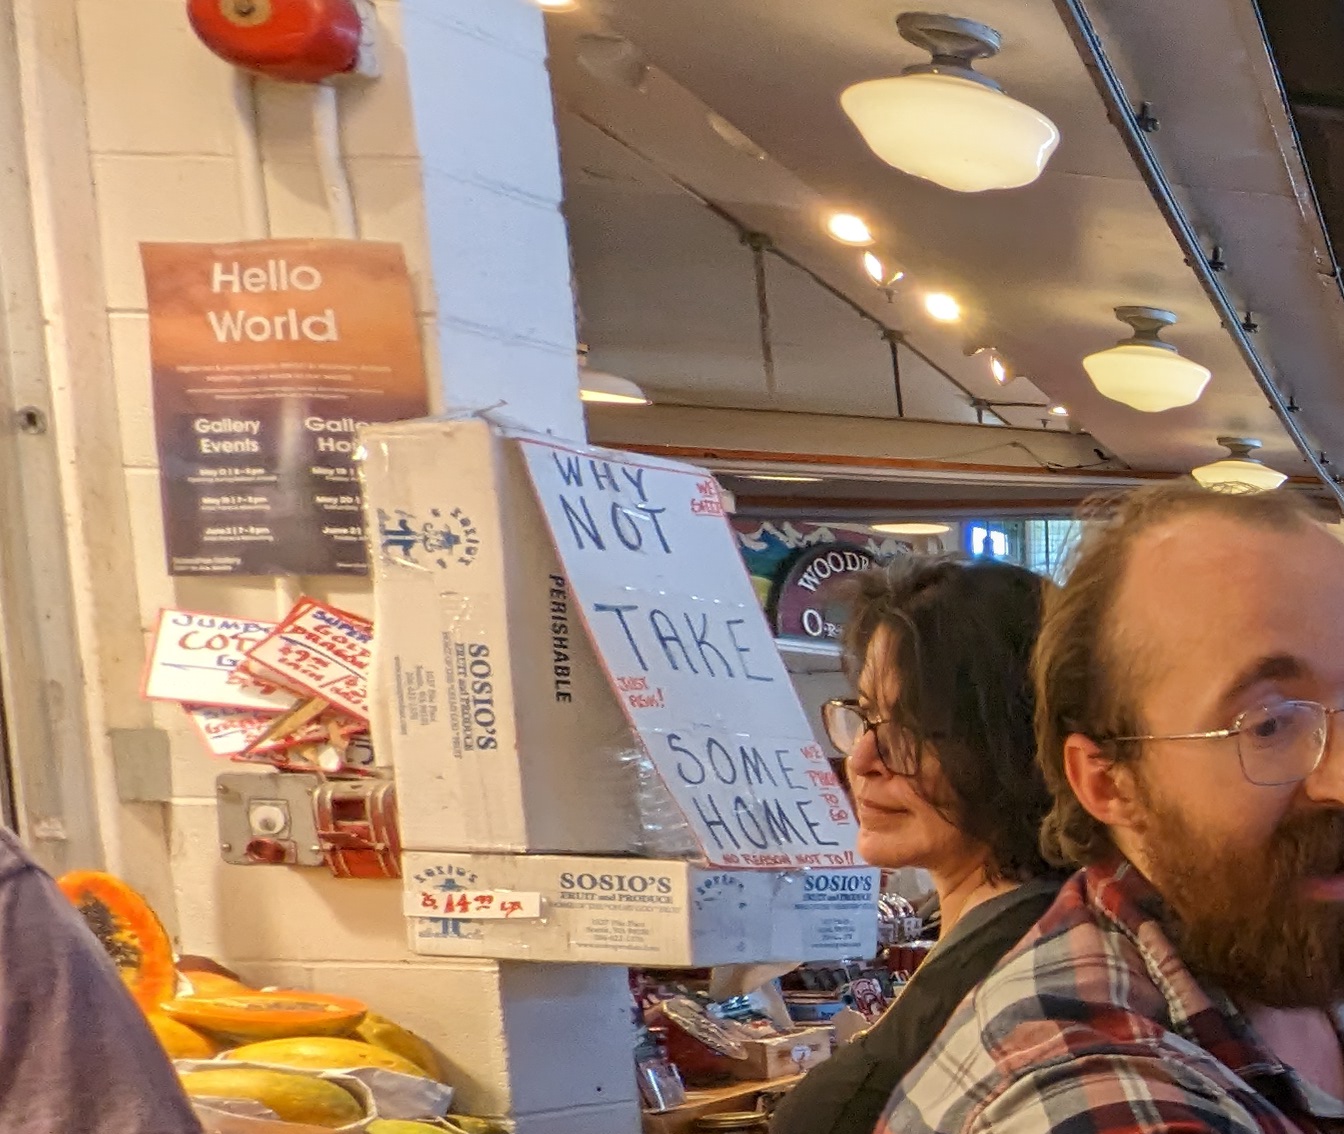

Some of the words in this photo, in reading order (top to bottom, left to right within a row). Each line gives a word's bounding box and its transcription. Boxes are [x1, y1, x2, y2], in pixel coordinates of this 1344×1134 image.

[211, 259, 323, 293] Hello
[207, 308, 340, 343] World
[194, 418, 261, 435] Gallery
[200, 437, 260, 453] Events
[553, 452, 648, 502] WHY
[559, 494, 672, 554] NOT
[548, 574, 572, 703] PERISHABLE
[594, 603, 774, 682] TAKE
[469, 643, 498, 751] SOSIO'S
[666, 733, 808, 791] SOME
[692, 794, 839, 850] HOME
[740, 853, 793, 865] REASON
[560, 872, 672, 894] SOSIO'S
[804, 875, 872, 892] SOSIO'S
